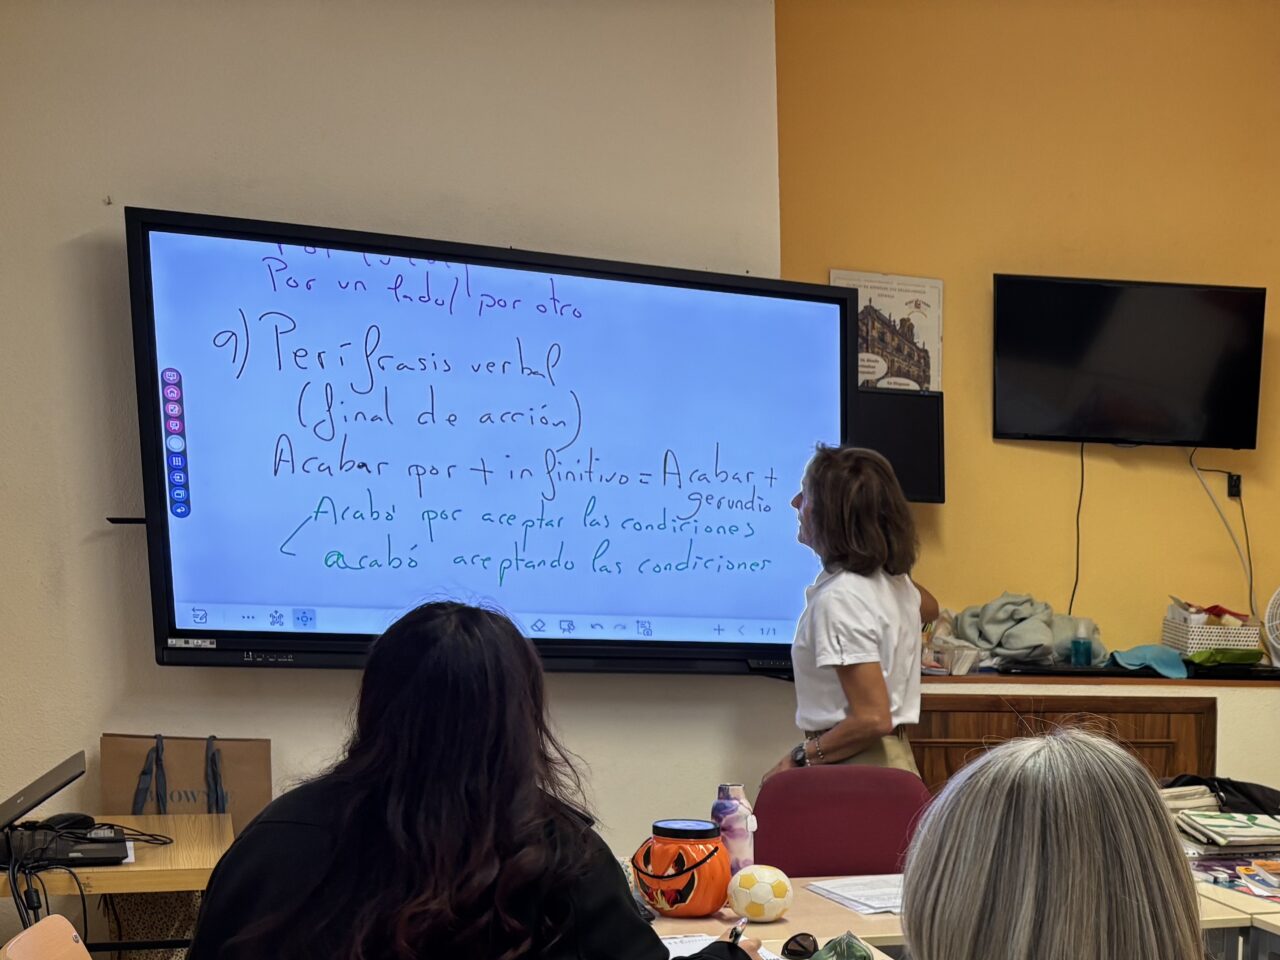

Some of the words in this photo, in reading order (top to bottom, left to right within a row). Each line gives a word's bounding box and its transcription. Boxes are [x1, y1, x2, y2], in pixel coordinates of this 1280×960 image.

[262, 256, 316, 292] Por
[338, 280, 367, 291] un
[479, 294, 522, 316] por
[536, 278, 582, 318] otro
[472, 336, 562, 386] verbal
[298, 381, 394, 441] (final
[417, 385, 458, 427] de
[273, 433, 389, 477] Acabar
[408, 464, 457, 498] por
[505, 447, 629, 501] infinitivo
[639, 473, 653, 485] =
[663, 442, 755, 489] Acabar
[422, 510, 462, 542] por
[482, 500, 564, 552] aceptar
[584, 495, 610, 528] las
[621, 507, 755, 538] condiciones
[676, 485, 772, 520] gerundio
[453, 541, 575, 587] aceptando
[592, 539, 622, 574] las
[638, 538, 772, 573] condiciones
